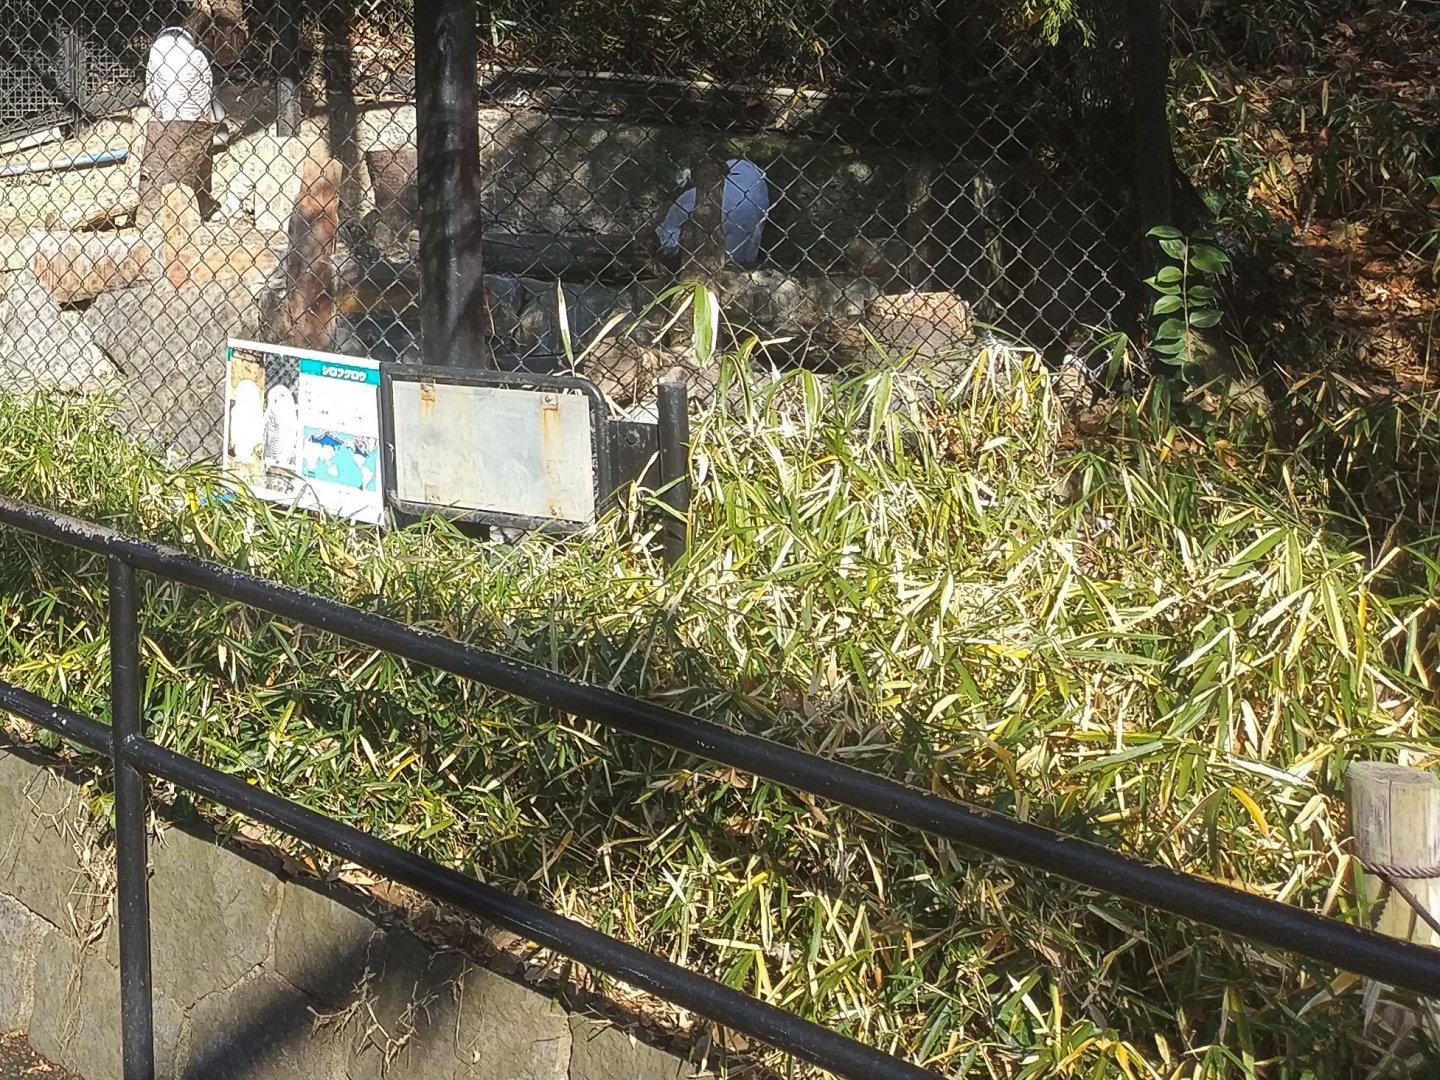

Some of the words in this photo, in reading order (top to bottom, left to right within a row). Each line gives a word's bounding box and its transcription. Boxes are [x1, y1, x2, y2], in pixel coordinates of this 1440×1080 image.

[322, 365, 367, 382] シロフクロウ
